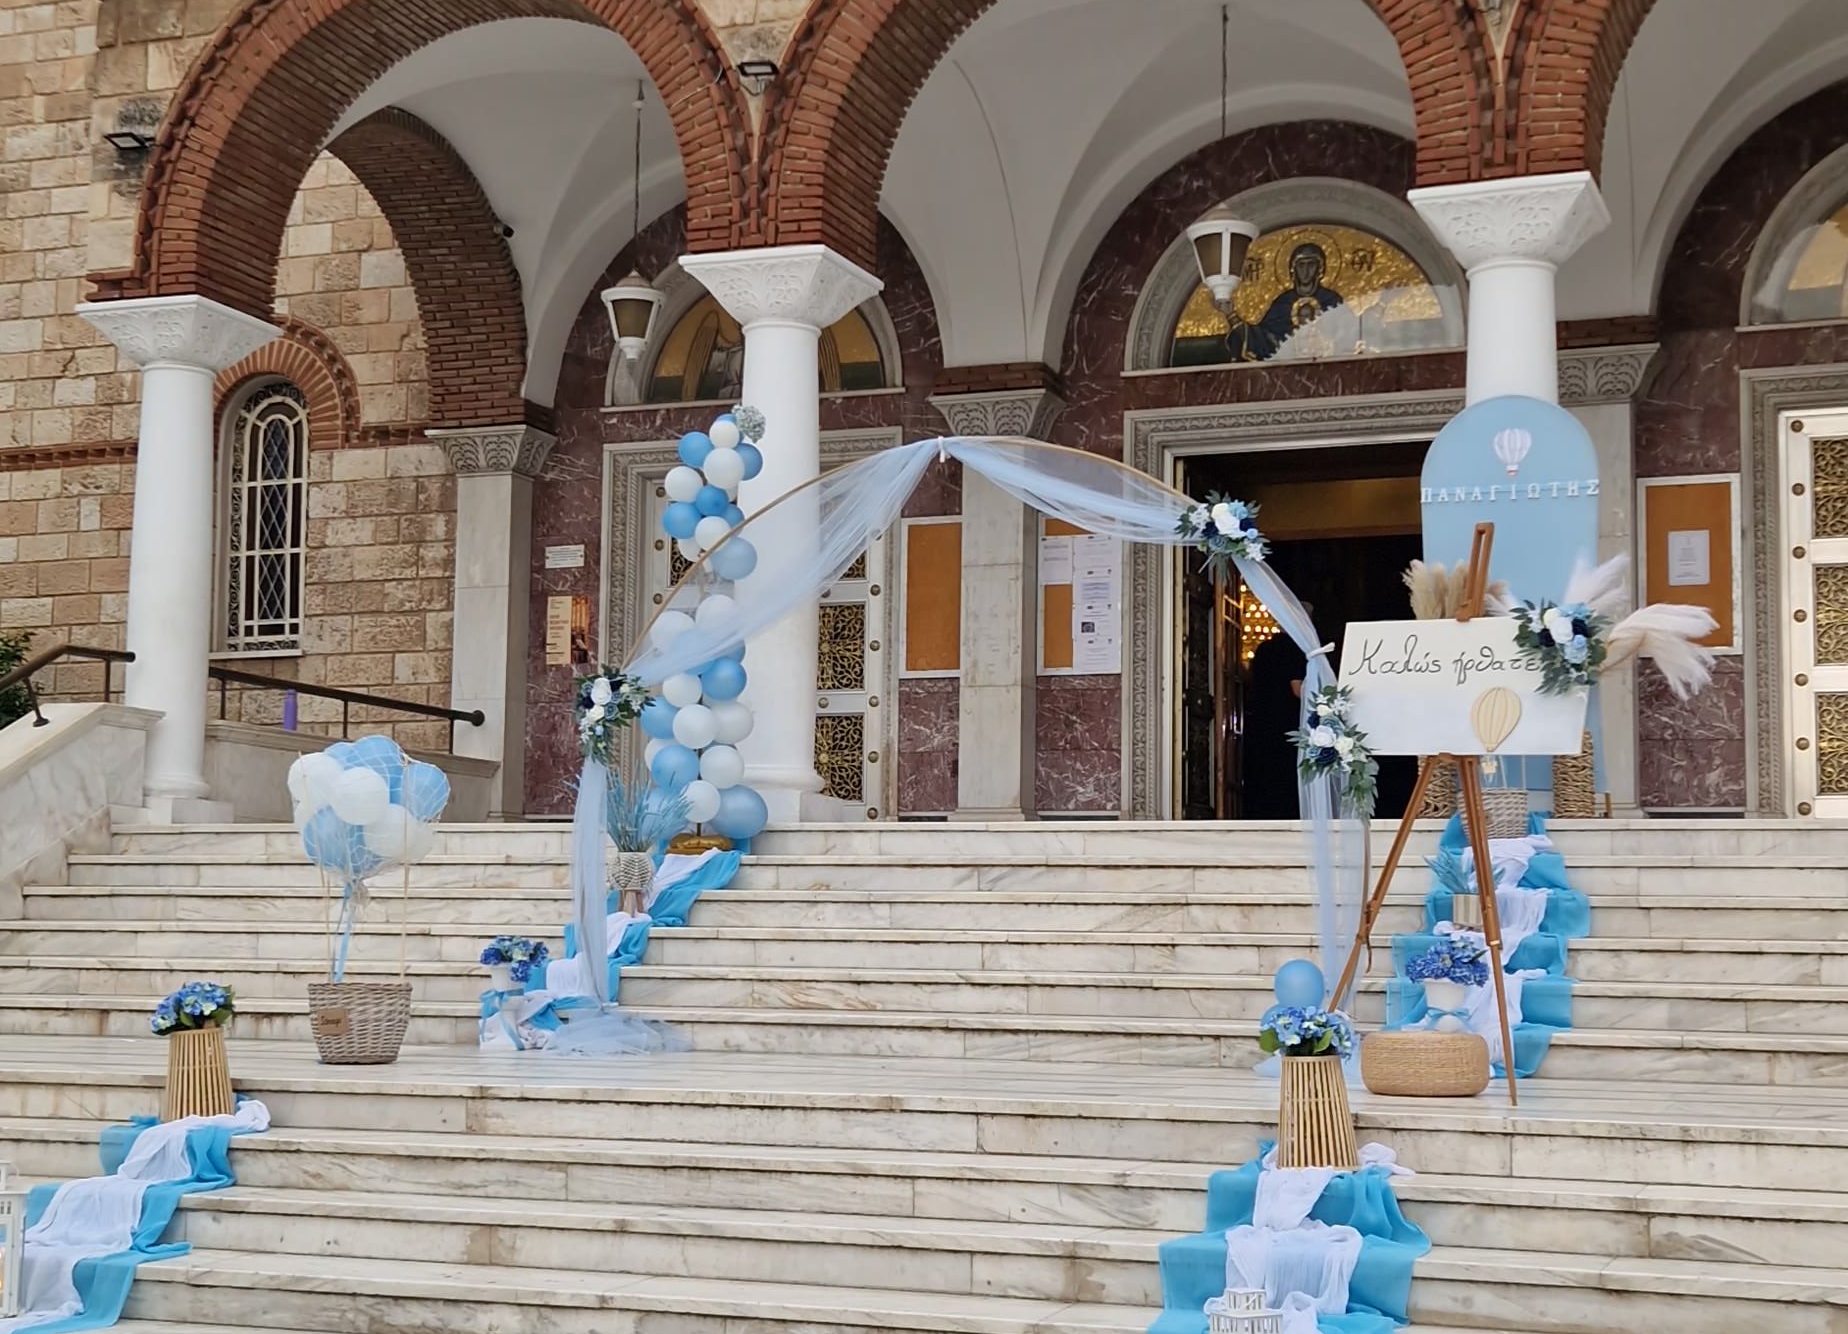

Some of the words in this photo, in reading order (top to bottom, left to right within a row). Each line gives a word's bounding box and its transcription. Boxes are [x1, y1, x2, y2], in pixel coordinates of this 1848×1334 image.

[1420, 479, 1600, 503] ΠΑΝΑΓΙΩΤΗΣ
[1349, 634, 1442, 676] Καλώς
[1452, 645, 1543, 686] ήρθατε
